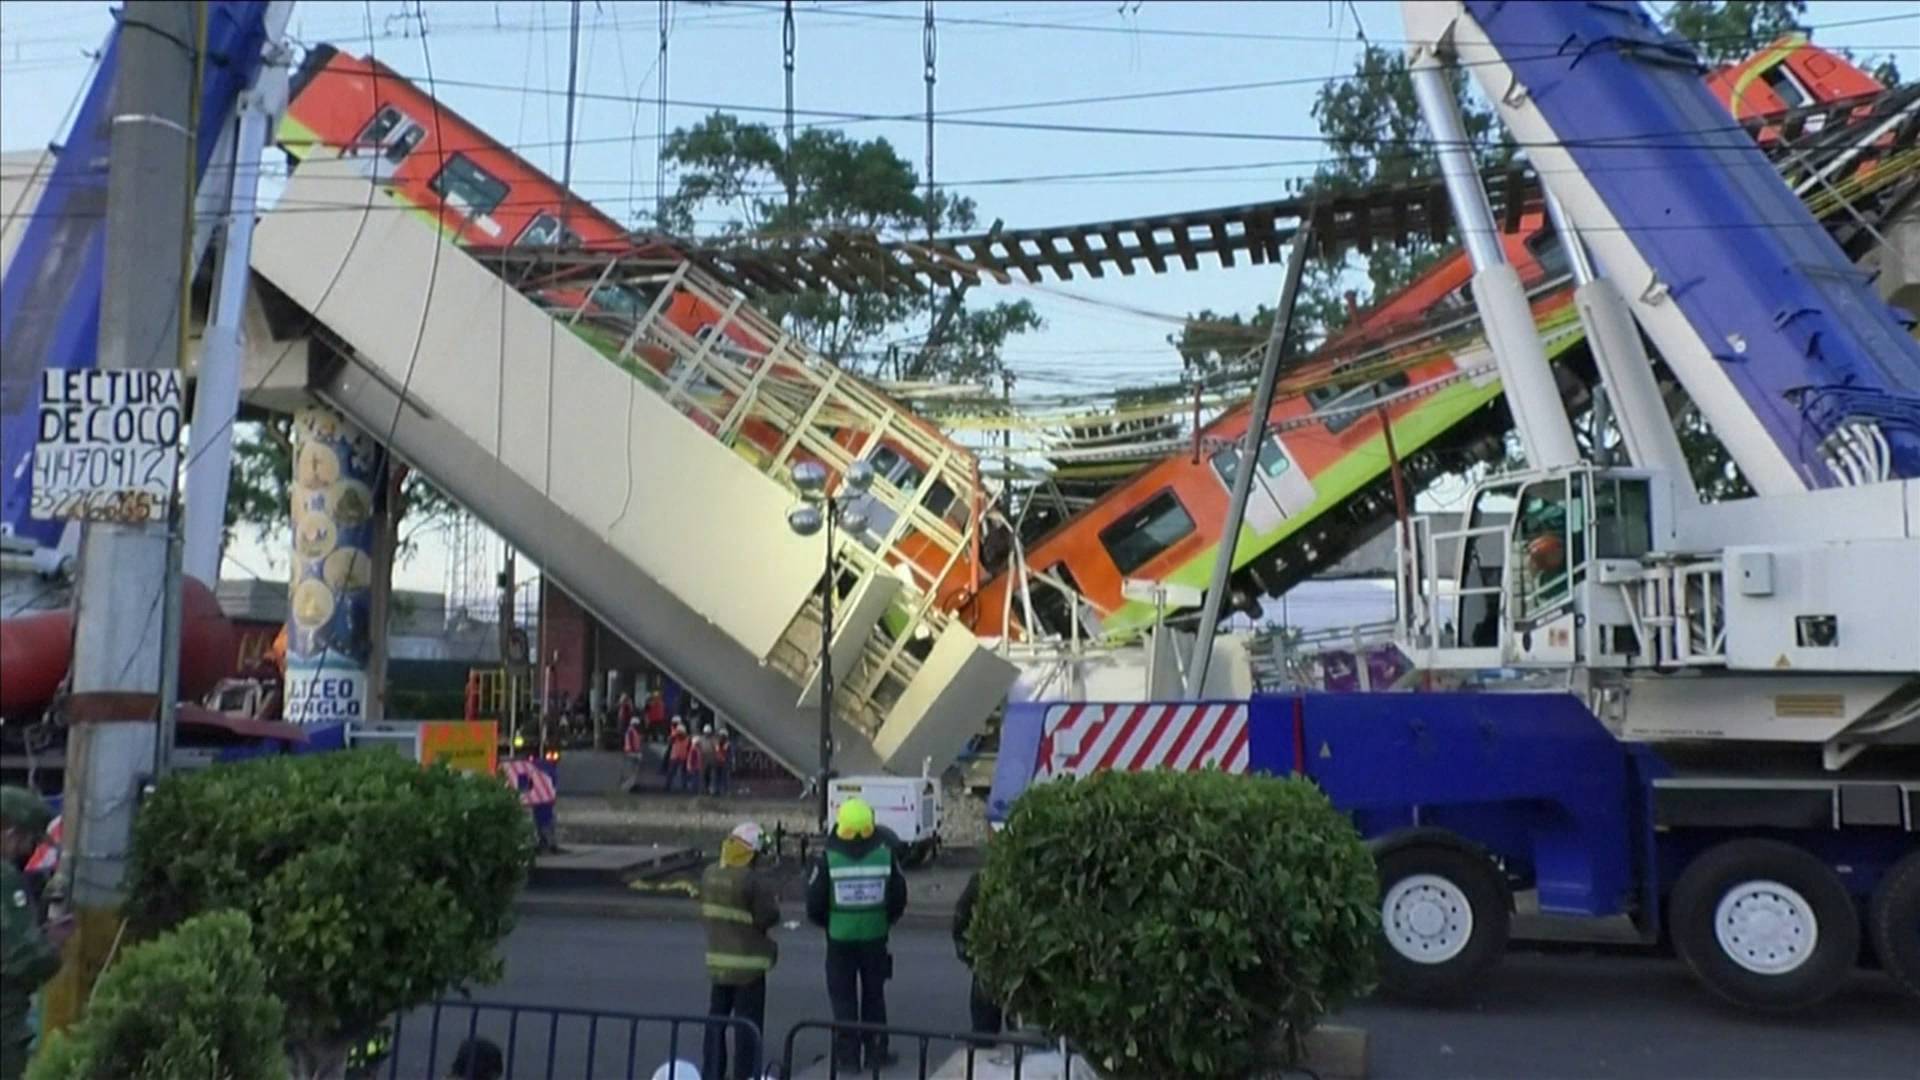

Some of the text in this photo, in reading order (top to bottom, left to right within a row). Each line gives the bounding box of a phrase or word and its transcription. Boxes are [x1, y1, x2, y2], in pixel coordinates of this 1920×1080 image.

[43, 370, 181, 404] LECTURA
[291, 679, 354, 699] LICEO
[290, 700, 360, 717] ANGLO
